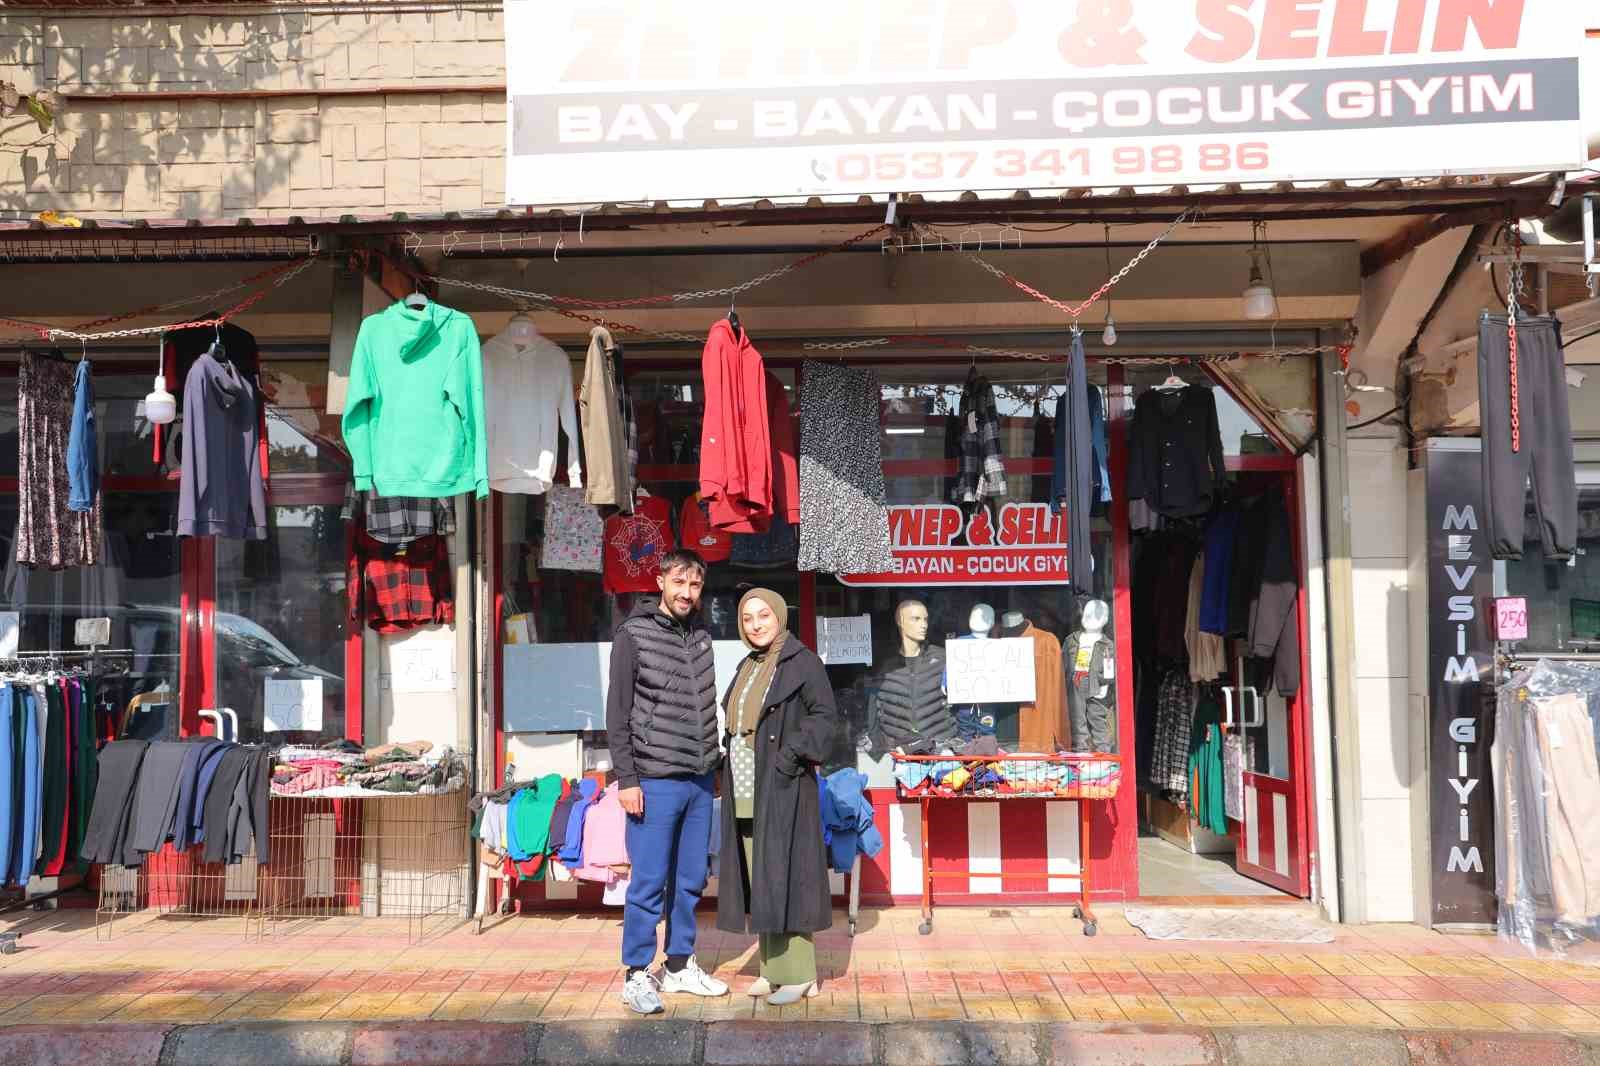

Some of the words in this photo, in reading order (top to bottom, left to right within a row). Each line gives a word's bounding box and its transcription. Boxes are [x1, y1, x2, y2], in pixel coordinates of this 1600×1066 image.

[1057, 0, 1149, 68] &
[557, 103, 701, 143] BAY
[753, 94, 998, 138] BAYAN
[1052, 83, 1311, 134] ÇOCUK
[835, 151, 980, 181] 0537
[993, 146, 1091, 178] 341
[1112, 143, 1184, 175] 98
[1198, 141, 1270, 172] 86
[892, 556, 954, 574] BAYAN
[967, 555, 1031, 576] ÇOCUK
[1033, 554, 1068, 573] GiYi
